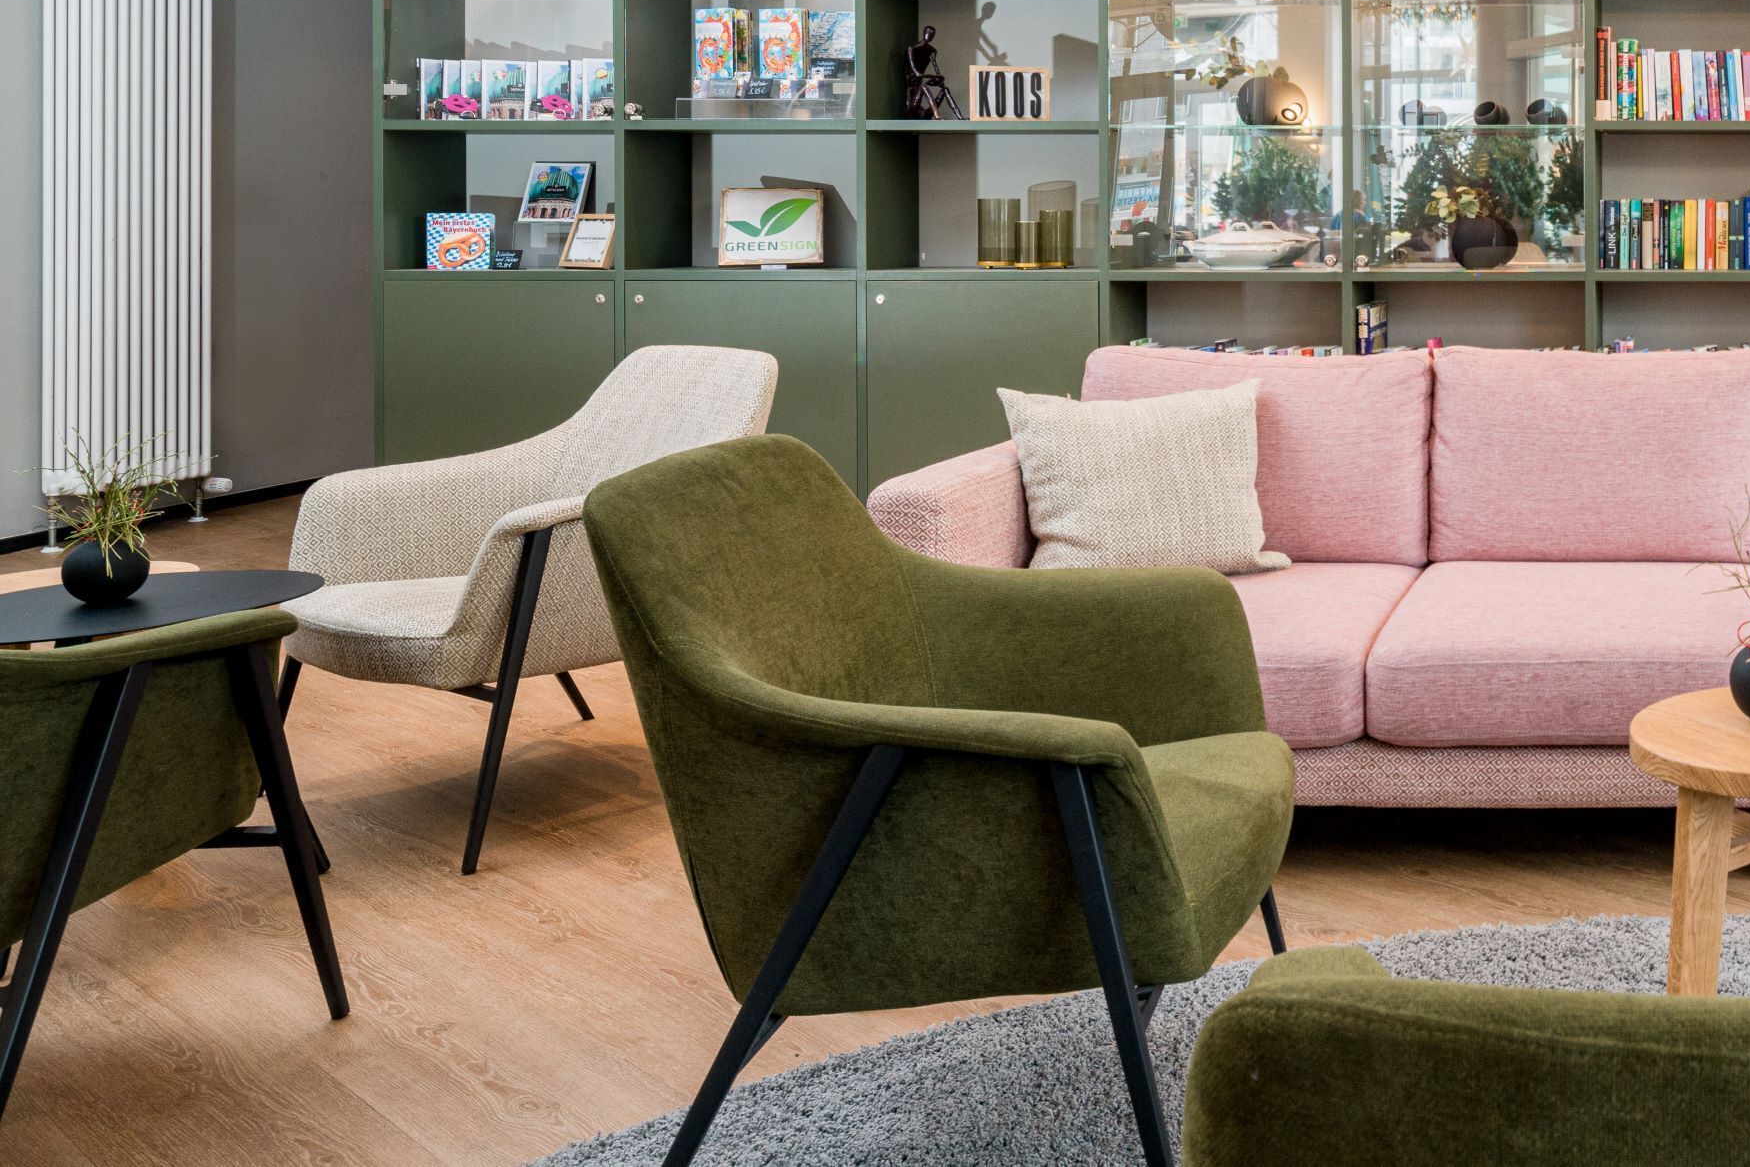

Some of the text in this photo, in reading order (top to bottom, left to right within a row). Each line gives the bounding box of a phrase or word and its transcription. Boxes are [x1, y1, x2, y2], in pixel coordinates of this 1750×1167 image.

[978, 71, 1043, 119] KOOS
[725, 240, 817, 252] GREENSIGN
[1608, 231, 1617, 254] LINK
